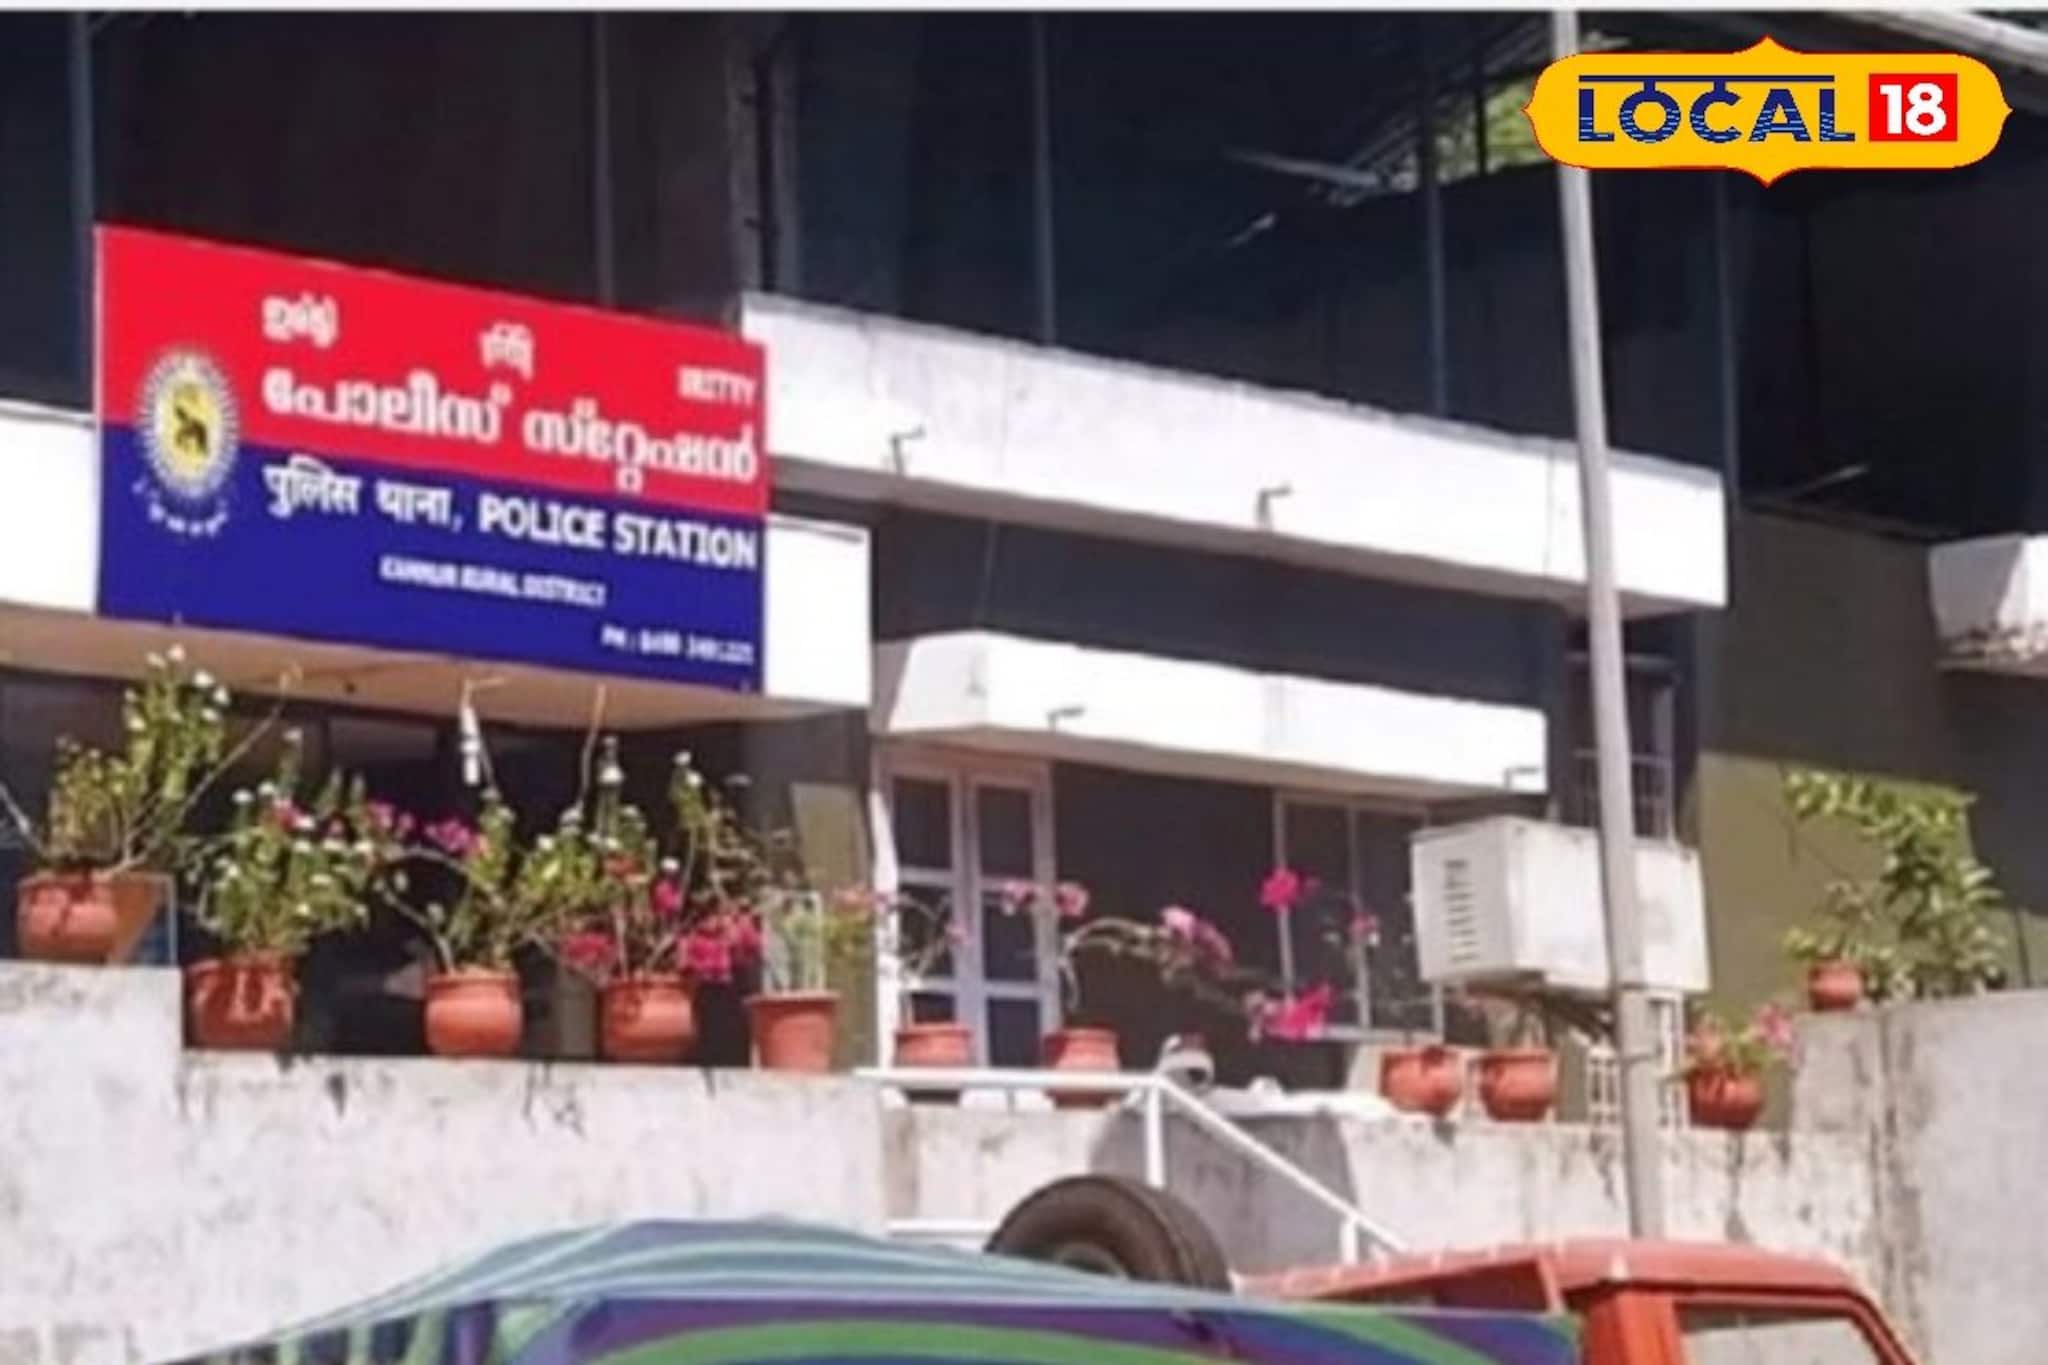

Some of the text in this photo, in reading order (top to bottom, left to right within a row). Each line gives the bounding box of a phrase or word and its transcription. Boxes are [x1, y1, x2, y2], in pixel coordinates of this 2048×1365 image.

[262, 453, 362, 519] पुलिस
[478, 493, 606, 549] POLICE
[612, 512, 758, 569] STATION
